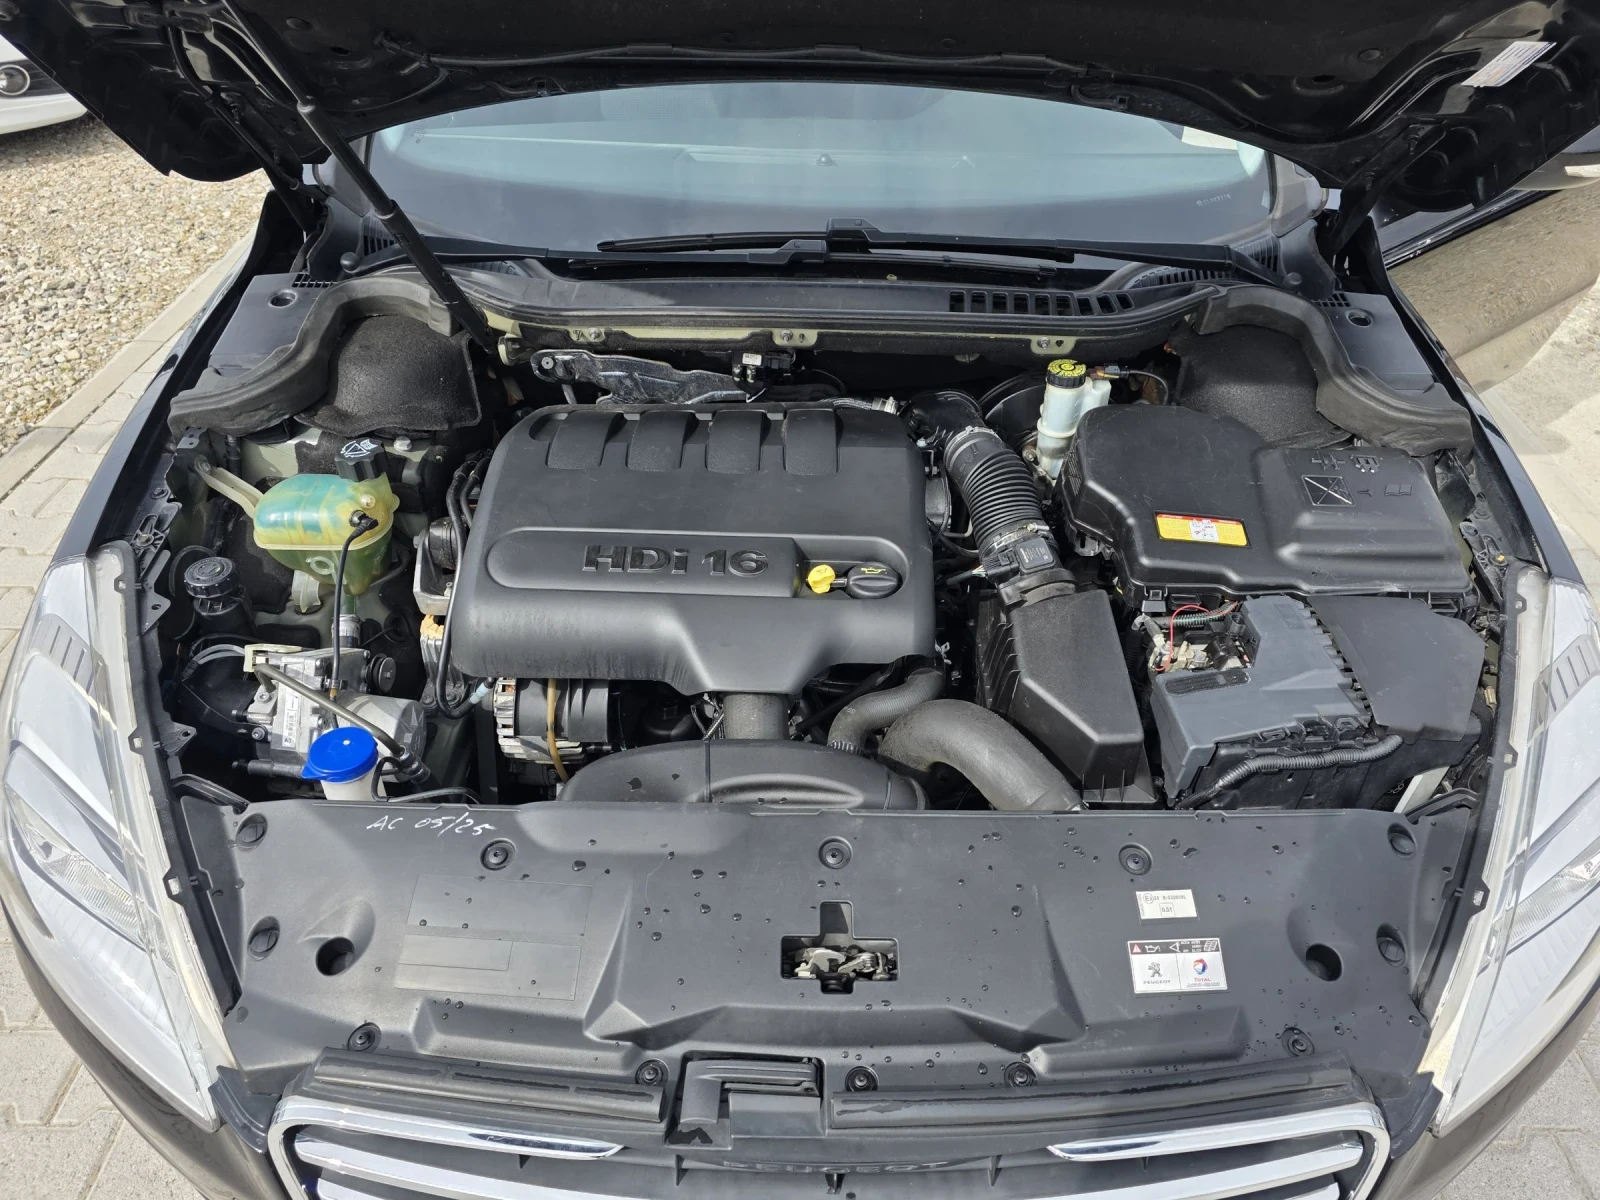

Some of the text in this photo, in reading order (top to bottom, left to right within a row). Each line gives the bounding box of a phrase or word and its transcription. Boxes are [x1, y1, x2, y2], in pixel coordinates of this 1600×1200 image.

[582, 545, 769, 577] HDi 16
[366, 811, 497, 837] AC 05/25
